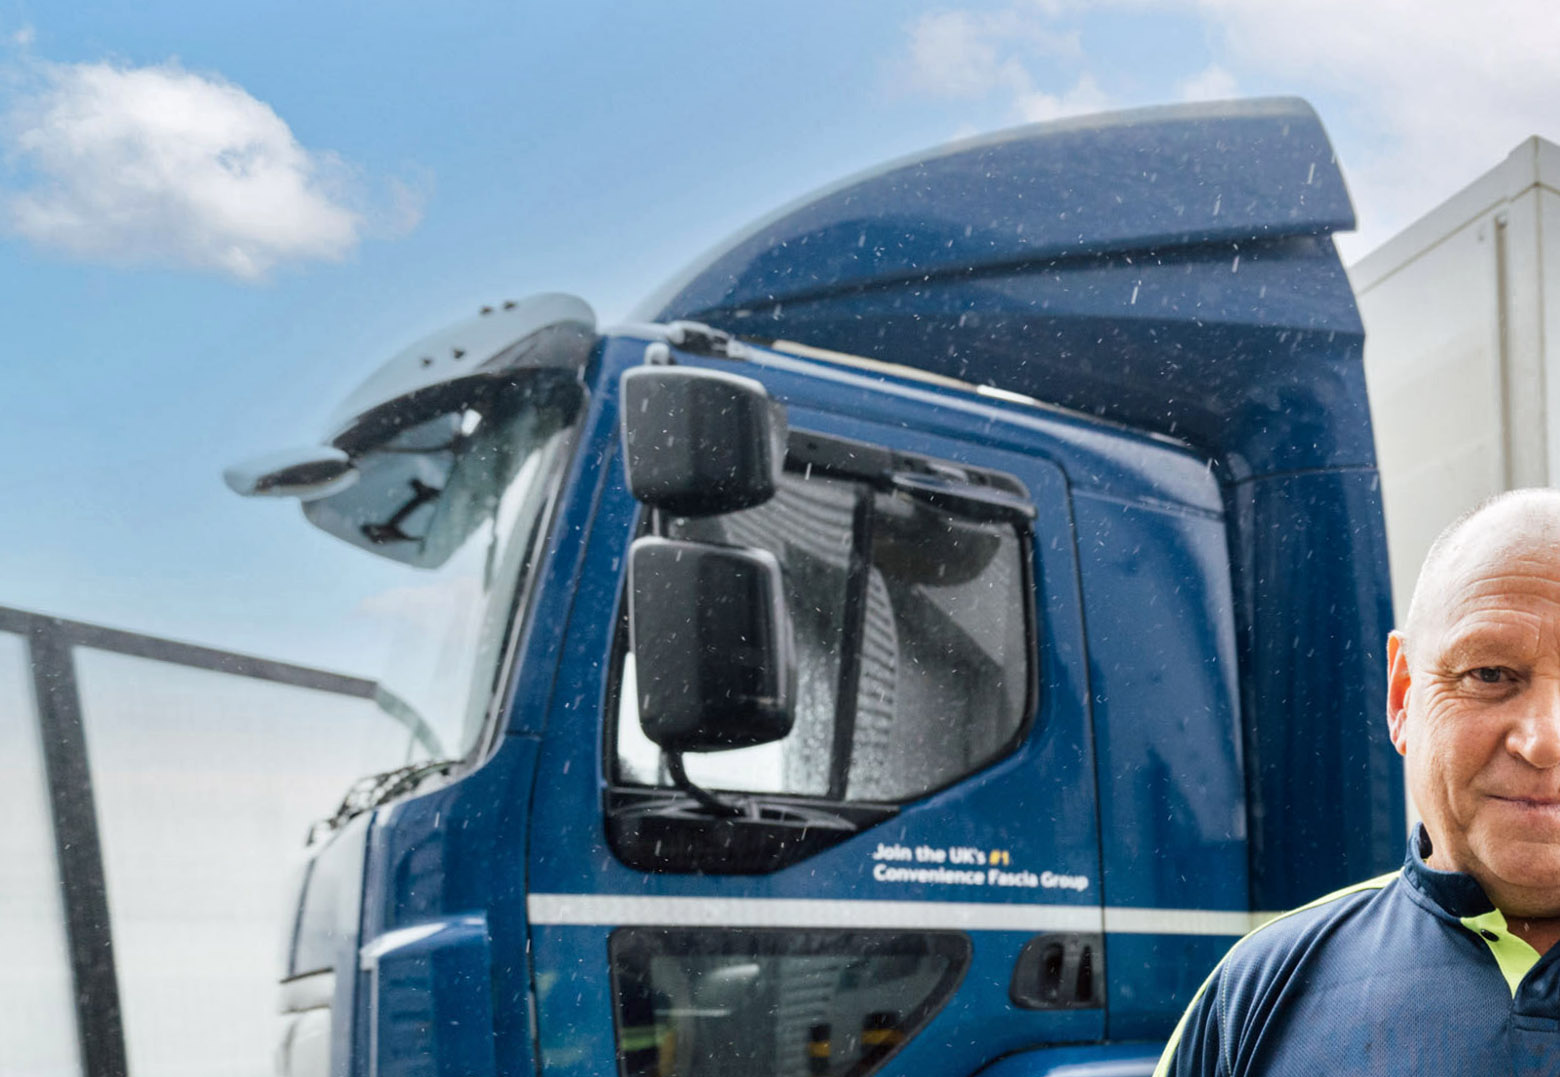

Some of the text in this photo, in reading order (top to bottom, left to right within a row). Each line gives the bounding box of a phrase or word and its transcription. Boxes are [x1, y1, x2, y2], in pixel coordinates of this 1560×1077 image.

[872, 843, 1010, 866] Join the UK's #1
[873, 863, 1089, 892] Convenience Fascia Group
